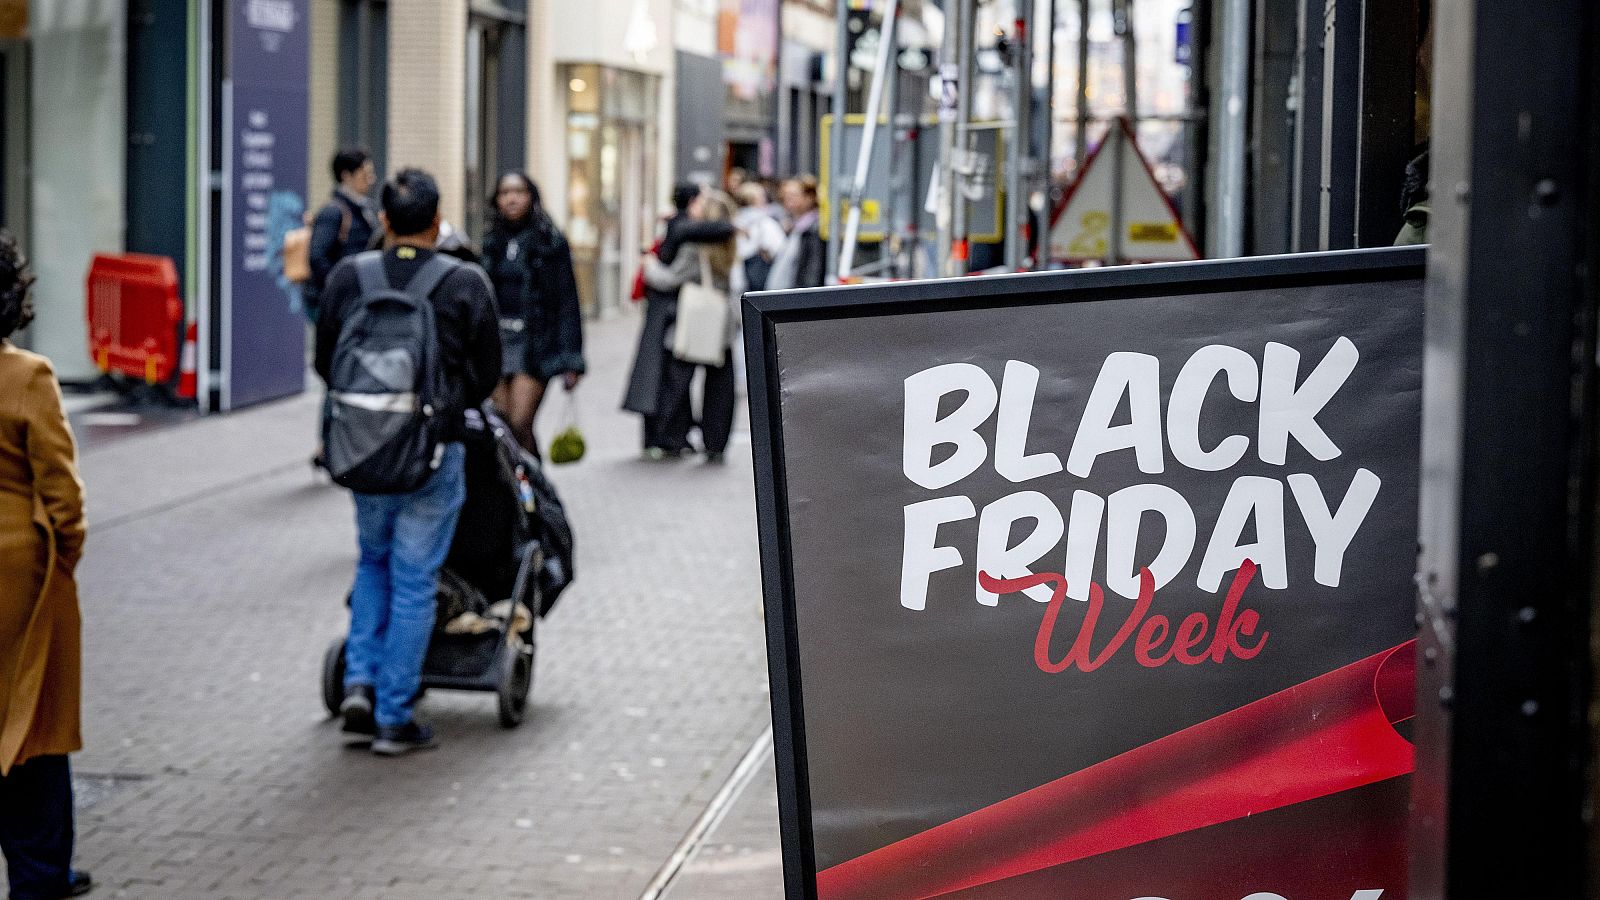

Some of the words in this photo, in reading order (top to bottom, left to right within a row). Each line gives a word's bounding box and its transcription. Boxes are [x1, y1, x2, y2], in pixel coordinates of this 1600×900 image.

[902, 335, 1360, 490] BLACK
[900, 467, 1382, 611] FRIDAY
[978, 558, 1270, 674] Week
